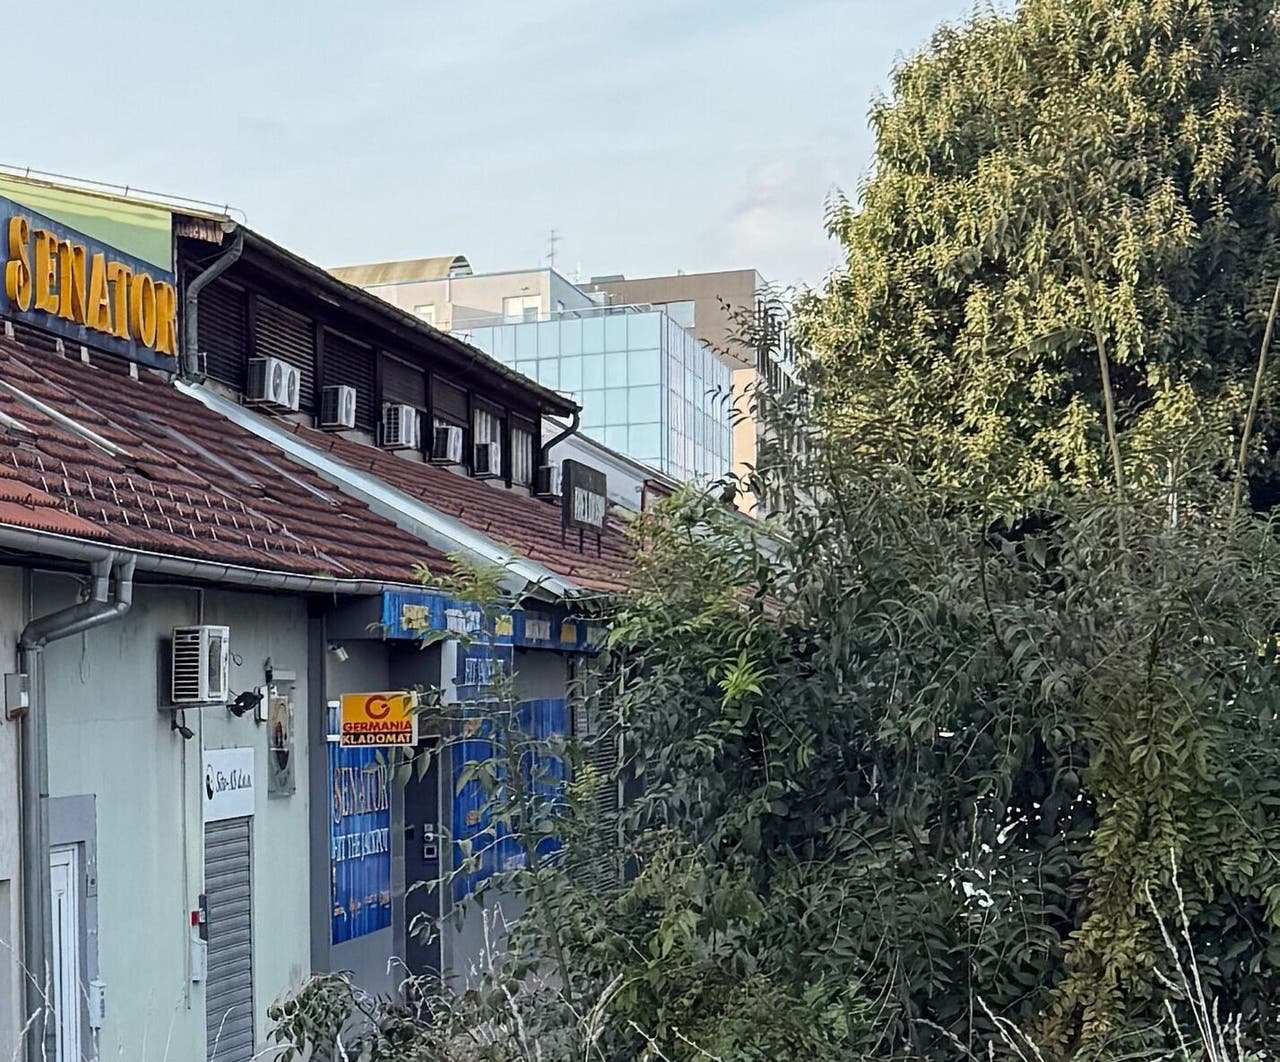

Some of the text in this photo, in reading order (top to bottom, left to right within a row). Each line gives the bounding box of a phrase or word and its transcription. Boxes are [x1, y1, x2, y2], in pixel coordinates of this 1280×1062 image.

[6, 215, 179, 357] SENATOR
[342, 720, 413, 732] GERMANIA
[342, 733, 412, 745] KLADOMAT
